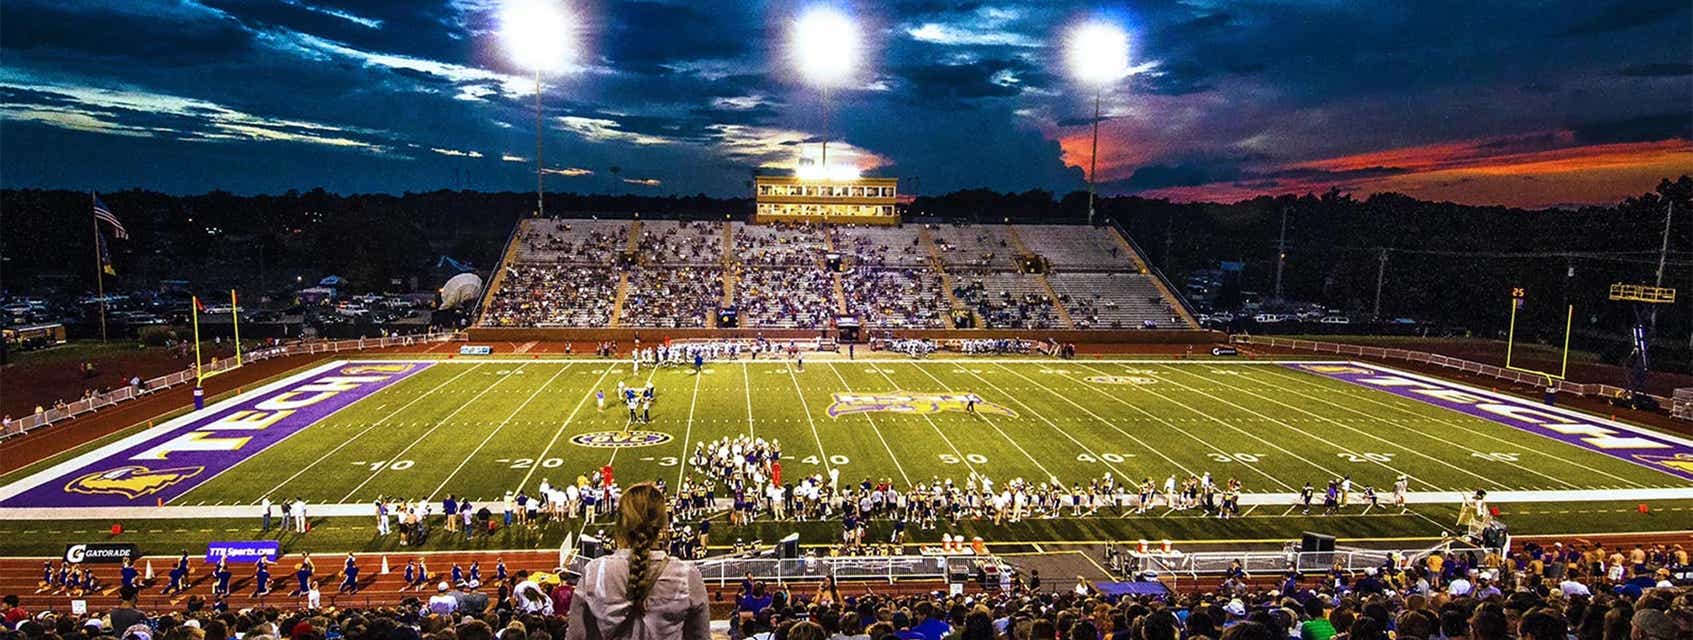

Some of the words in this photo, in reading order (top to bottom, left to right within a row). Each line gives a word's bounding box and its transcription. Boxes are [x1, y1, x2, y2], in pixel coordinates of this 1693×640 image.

[1512, 287, 1525, 297] 25
[128, 375, 392, 460] TECH
[1355, 376, 1674, 449] TECH
[658, 456, 709, 466] 30
[801, 455, 850, 465] 40
[938, 453, 988, 464] 50
[1076, 453, 1125, 463] 40
[1206, 453, 1259, 463] 30
[1337, 452, 1392, 462] 20
[369, 460, 416, 470] 10
[510, 458, 564, 468] 20
[67, 544, 86, 563] G
[85, 549, 131, 557] GATORADE
